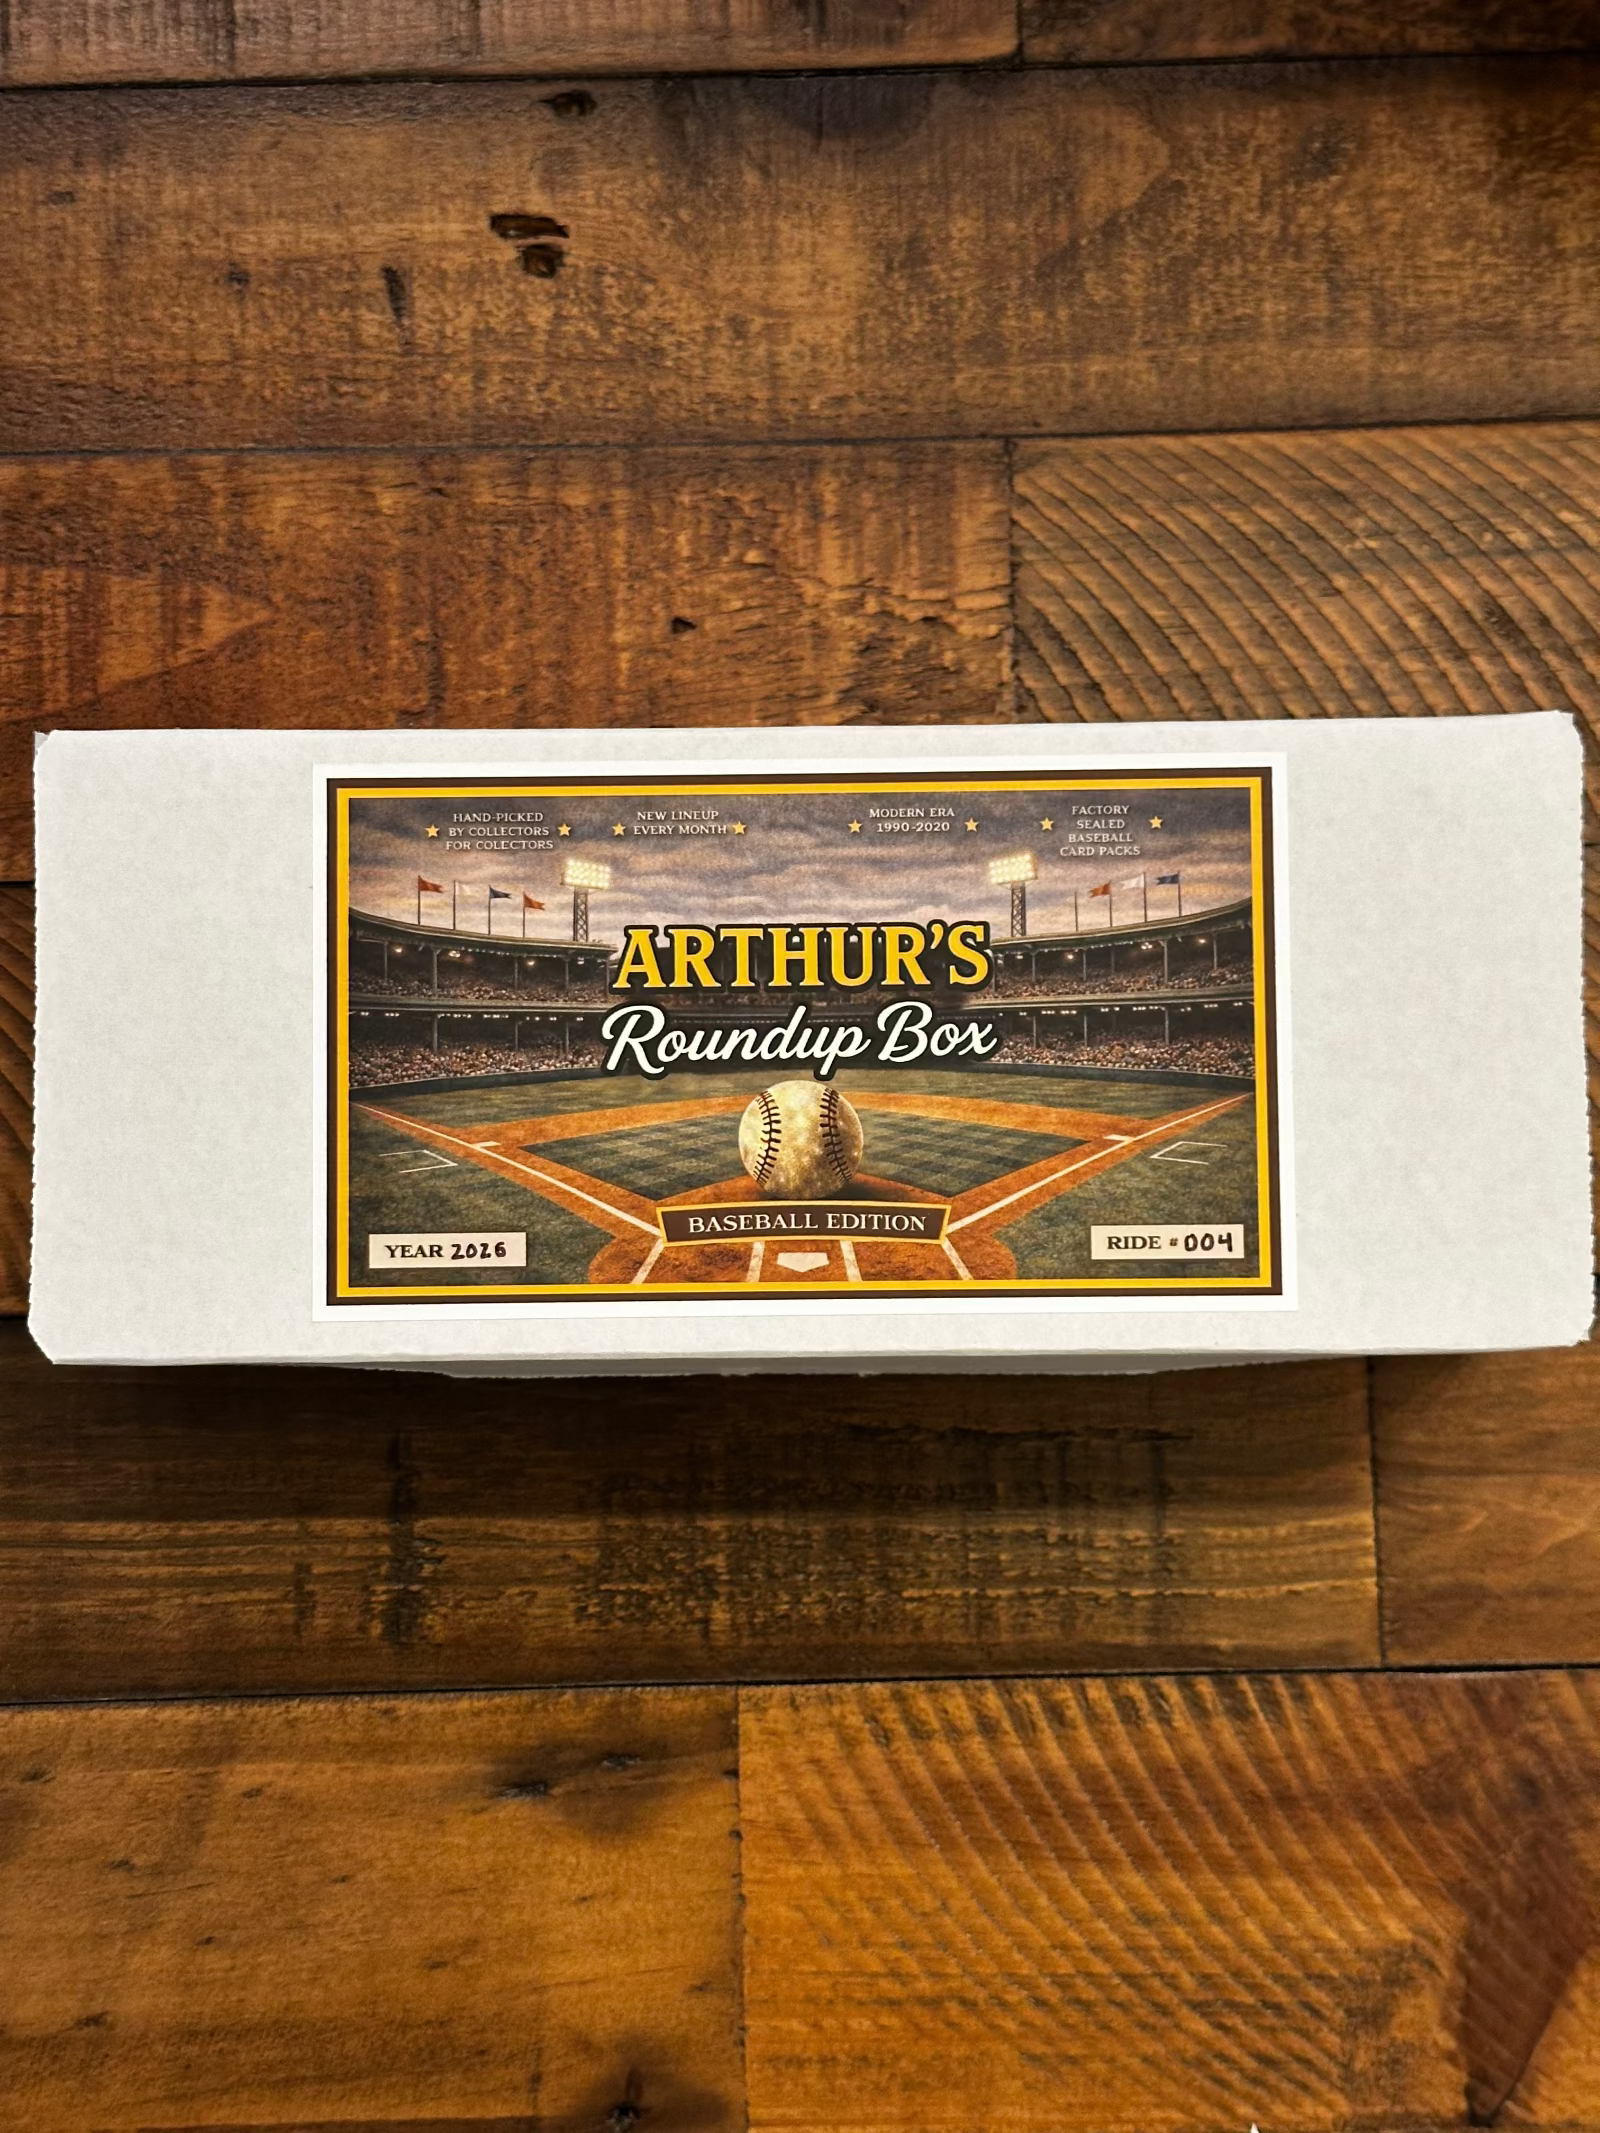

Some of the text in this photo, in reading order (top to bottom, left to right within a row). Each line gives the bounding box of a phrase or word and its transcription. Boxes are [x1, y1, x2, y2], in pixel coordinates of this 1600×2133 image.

[868, 807, 956, 818] MODERN ERA
[1071, 804, 1130, 815] FACTORY
[453, 812, 544, 823] HAND-PICKED
[636, 810, 720, 821] NEW LINEUP
[633, 824, 728, 835] EVERY MONTH
[875, 821, 951, 833] 1990-2020
[1076, 819, 1126, 829] SEALED
[448, 826, 550, 837] BY COLLECTORS
[1068, 833, 1134, 843] BASEBALL
[446, 840, 554, 850] FOR COLECTORS
[1059, 845, 1141, 857] CARD PACKS
[612, 922, 990, 989] ARTHUR'S
[601, 1000, 998, 1076] Roundup Box
[687, 1212, 927, 1234] BASEBALL EDITION
[1106, 1235, 1162, 1250] RIDE
[384, 1241, 507, 1261] YEAR 2026
